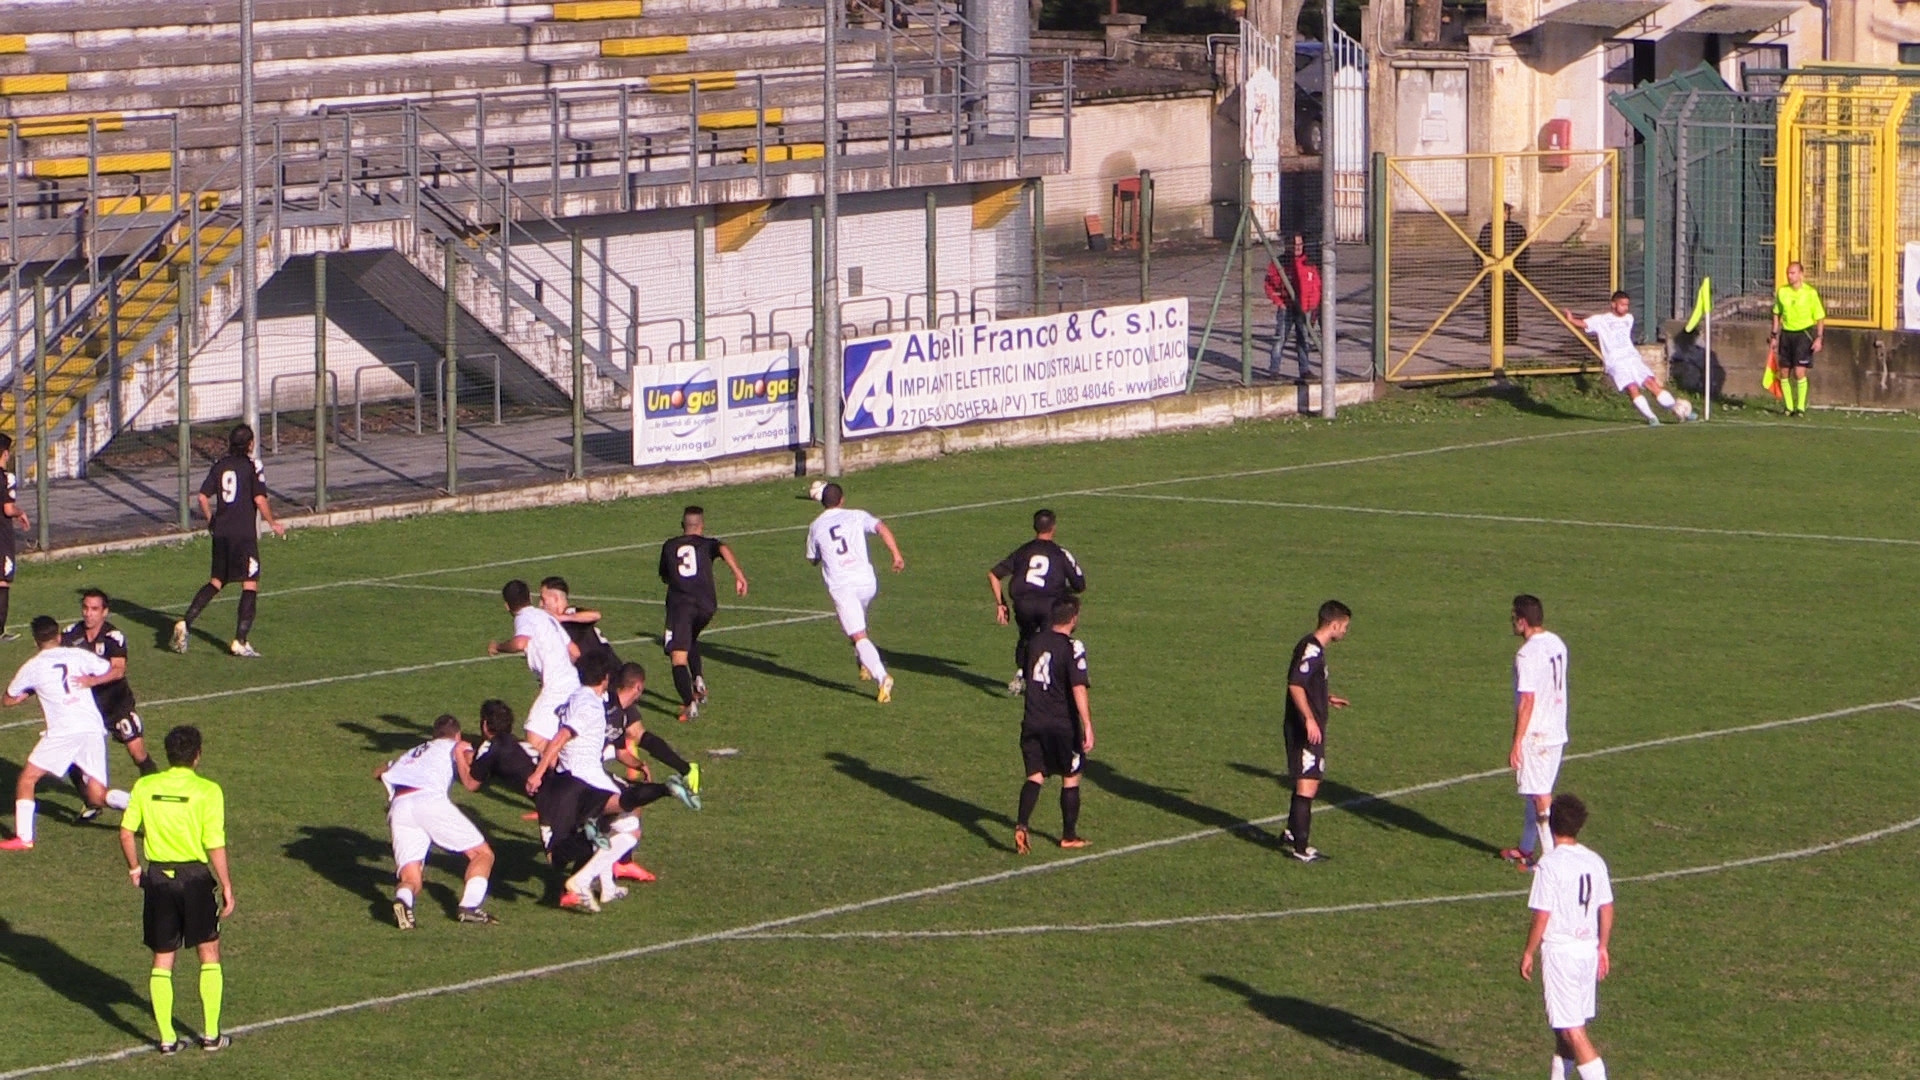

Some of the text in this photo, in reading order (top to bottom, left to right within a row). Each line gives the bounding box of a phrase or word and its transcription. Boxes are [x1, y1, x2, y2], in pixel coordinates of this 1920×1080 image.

[902, 328, 964, 364] Abeli
[973, 325, 1058, 354] Franco
[1066, 313, 1082, 342] &
[900, 372, 952, 398] IMPIANTI
[955, 365, 1017, 391] ELETTRICI
[1107, 339, 1186, 369] FOTOVLTAICI
[1001, 394, 1027, 417] (PV)
[1056, 386, 1079, 405] 0383
[1082, 381, 1115, 400] 48046
[221, 469, 237, 503] 9
[828, 524, 848, 555] 5
[677, 544, 698, 577] 3
[1026, 554, 1050, 588] 2
[52, 663, 71, 694] 7
[1032, 651, 1051, 691] 4
[1550, 652, 1563, 691] 11
[1579, 873, 1592, 918] 4
